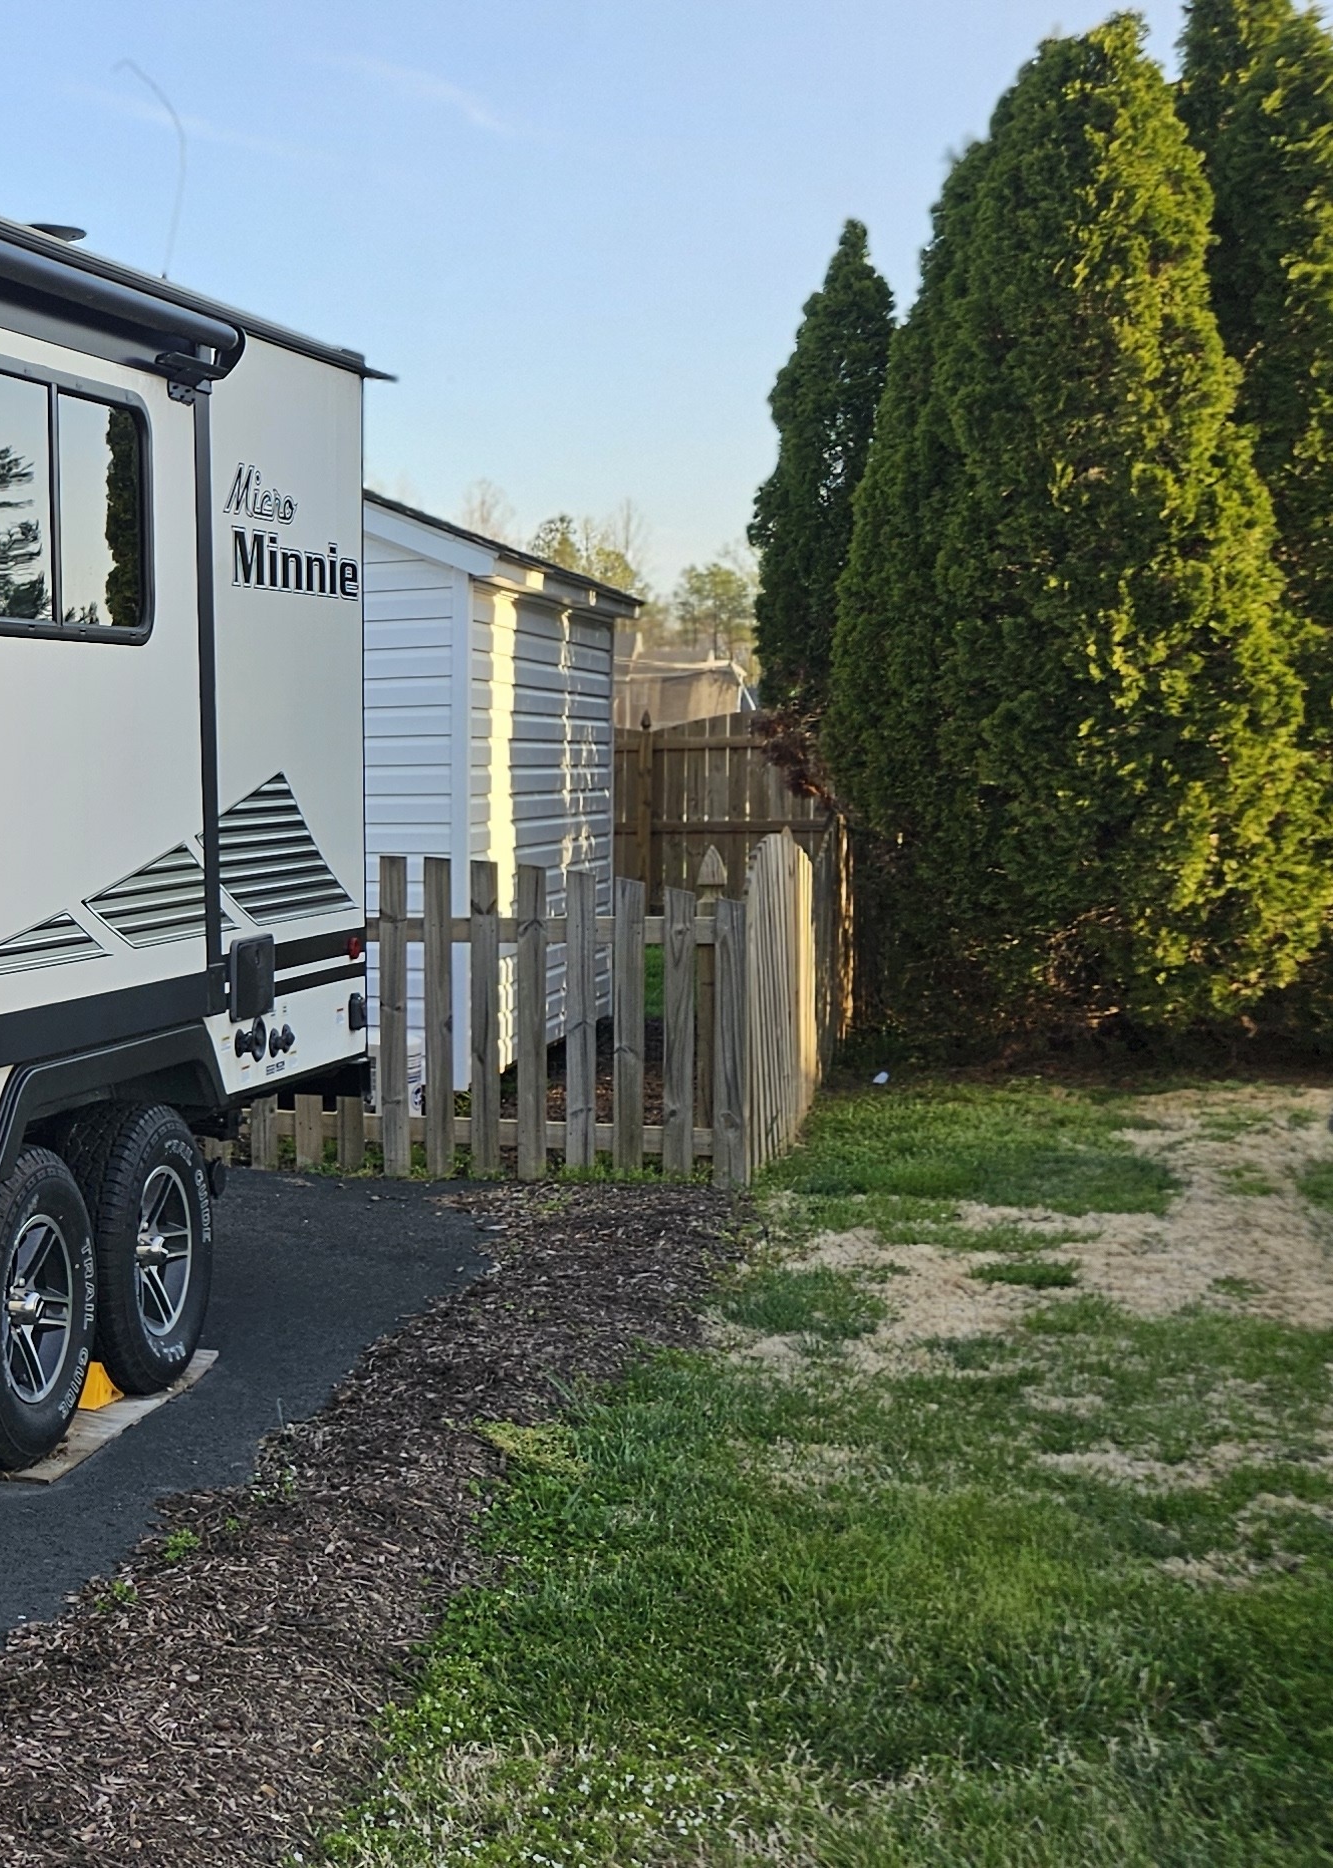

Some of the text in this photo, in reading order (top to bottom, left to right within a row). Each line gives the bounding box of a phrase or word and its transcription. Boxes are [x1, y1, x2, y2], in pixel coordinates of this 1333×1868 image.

[223, 462, 298, 525] Micro
[231, 525, 359, 601] Minnie
[194, 1169, 212, 1243] GUIDE
[57, 1238, 95, 1420] TRAIL GUIDE
